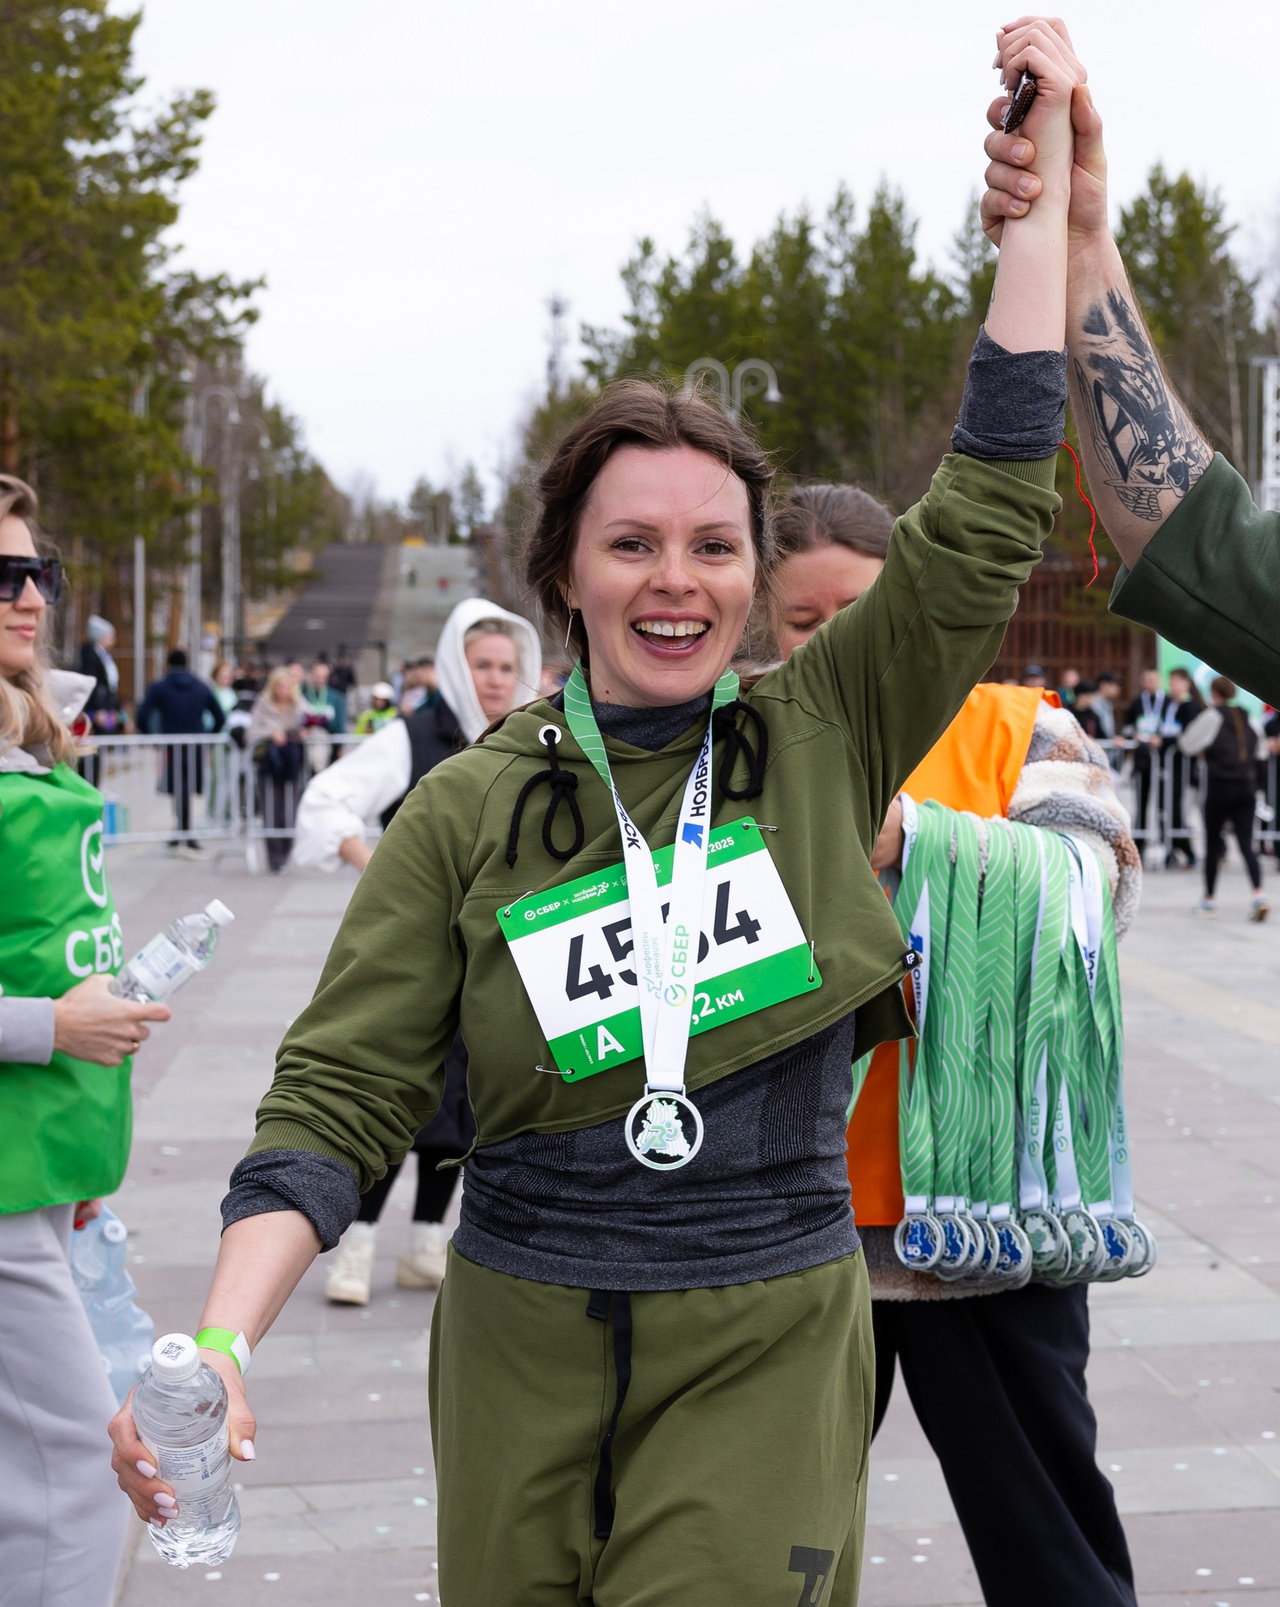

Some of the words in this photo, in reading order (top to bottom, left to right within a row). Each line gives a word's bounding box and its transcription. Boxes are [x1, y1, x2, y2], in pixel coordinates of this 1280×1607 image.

[690, 726, 709, 818] НОЯБРЬС
[536, 902, 560, 915] СБЕР
[65, 912, 123, 977] СБЕ
[565, 880, 762, 1001] 454
[671, 925, 689, 978] СБЕР
[691, 992, 716, 1025] ,2
[1030, 1098, 1040, 1137] СБЕР
